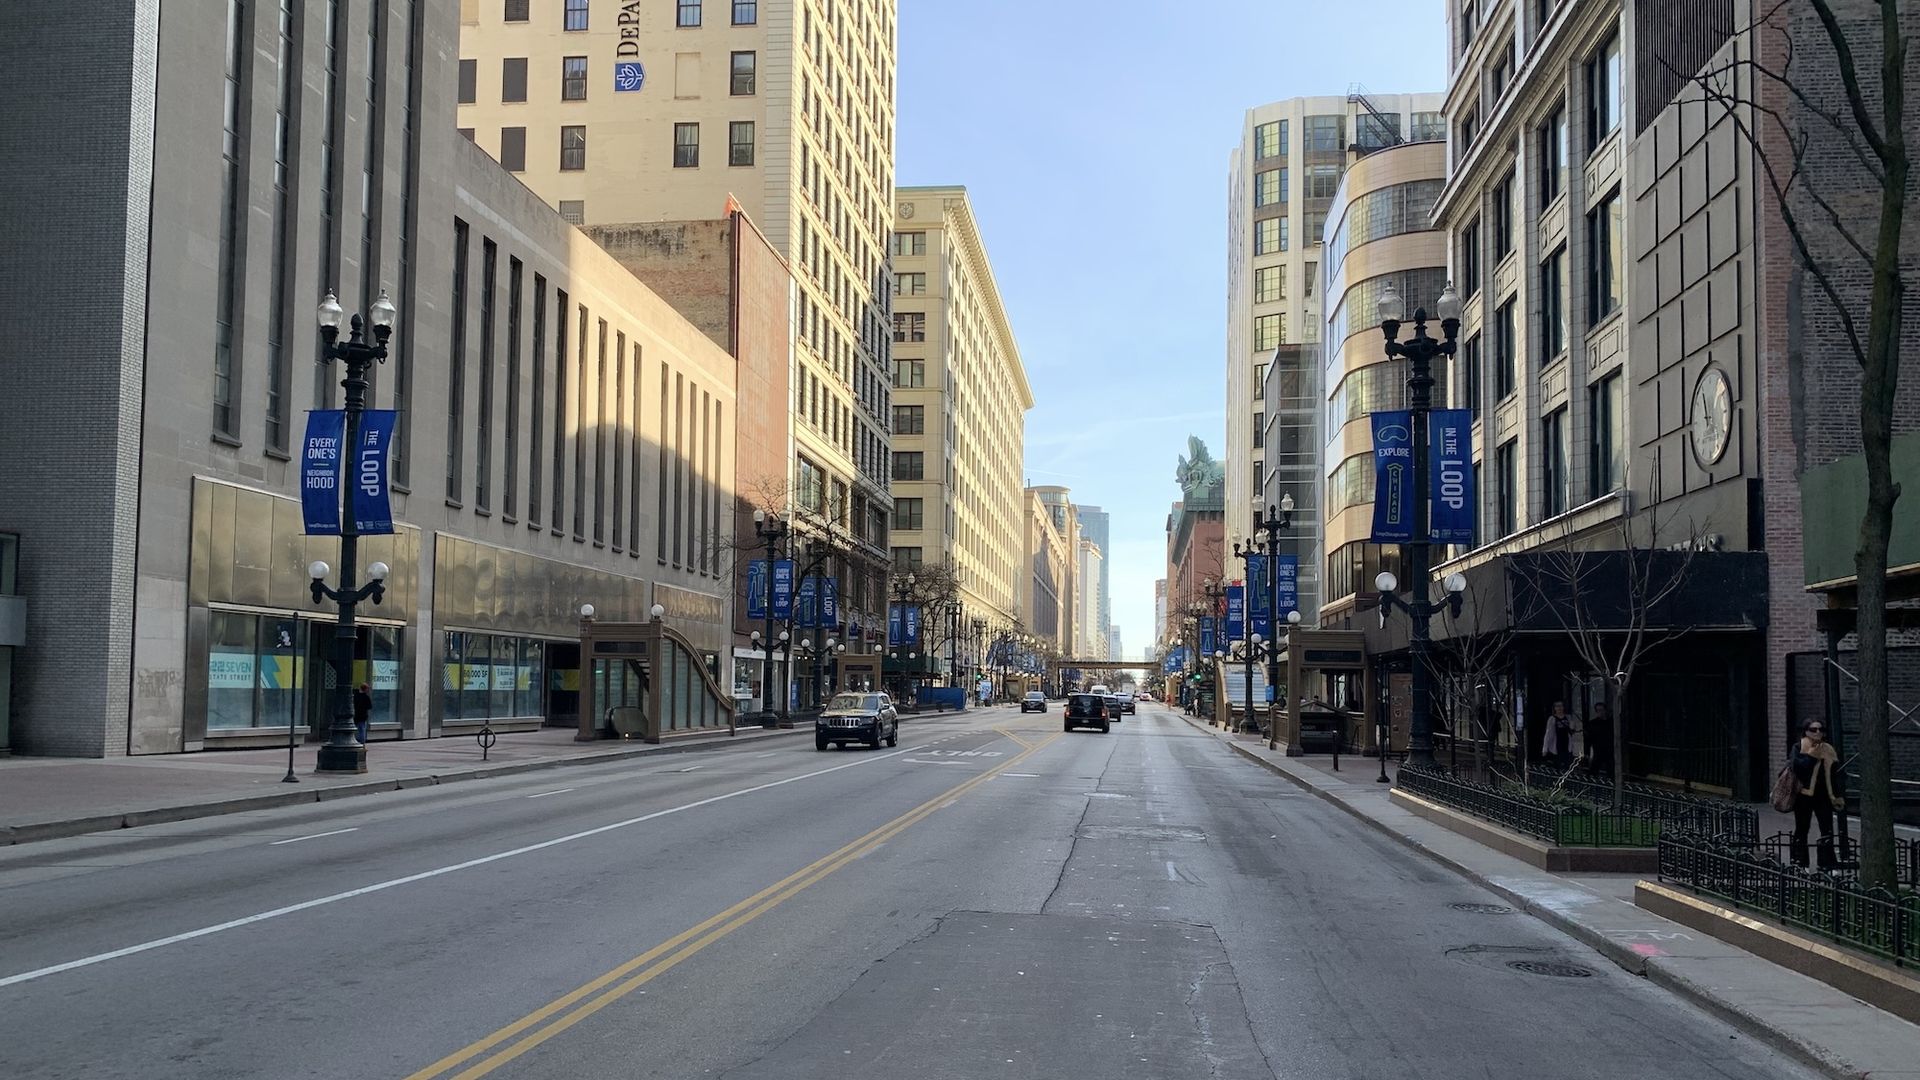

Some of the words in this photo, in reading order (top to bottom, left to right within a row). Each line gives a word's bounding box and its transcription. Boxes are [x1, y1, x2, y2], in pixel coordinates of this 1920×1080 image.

[616, 0, 640, 58] DEPA
[368, 430, 379, 446] THE
[1445, 427, 1457, 437] IN
[309, 437, 337, 448] EVERY
[1445, 438, 1457, 455] THE
[307, 448, 336, 459] ONE'S
[1378, 447, 1410, 458] EXPLORE
[361, 450, 380, 497] LOOP
[306, 477, 335, 489] HOOD
[1440, 460, 1464, 509] LOOP
[824, 597, 833, 616] LOOP
